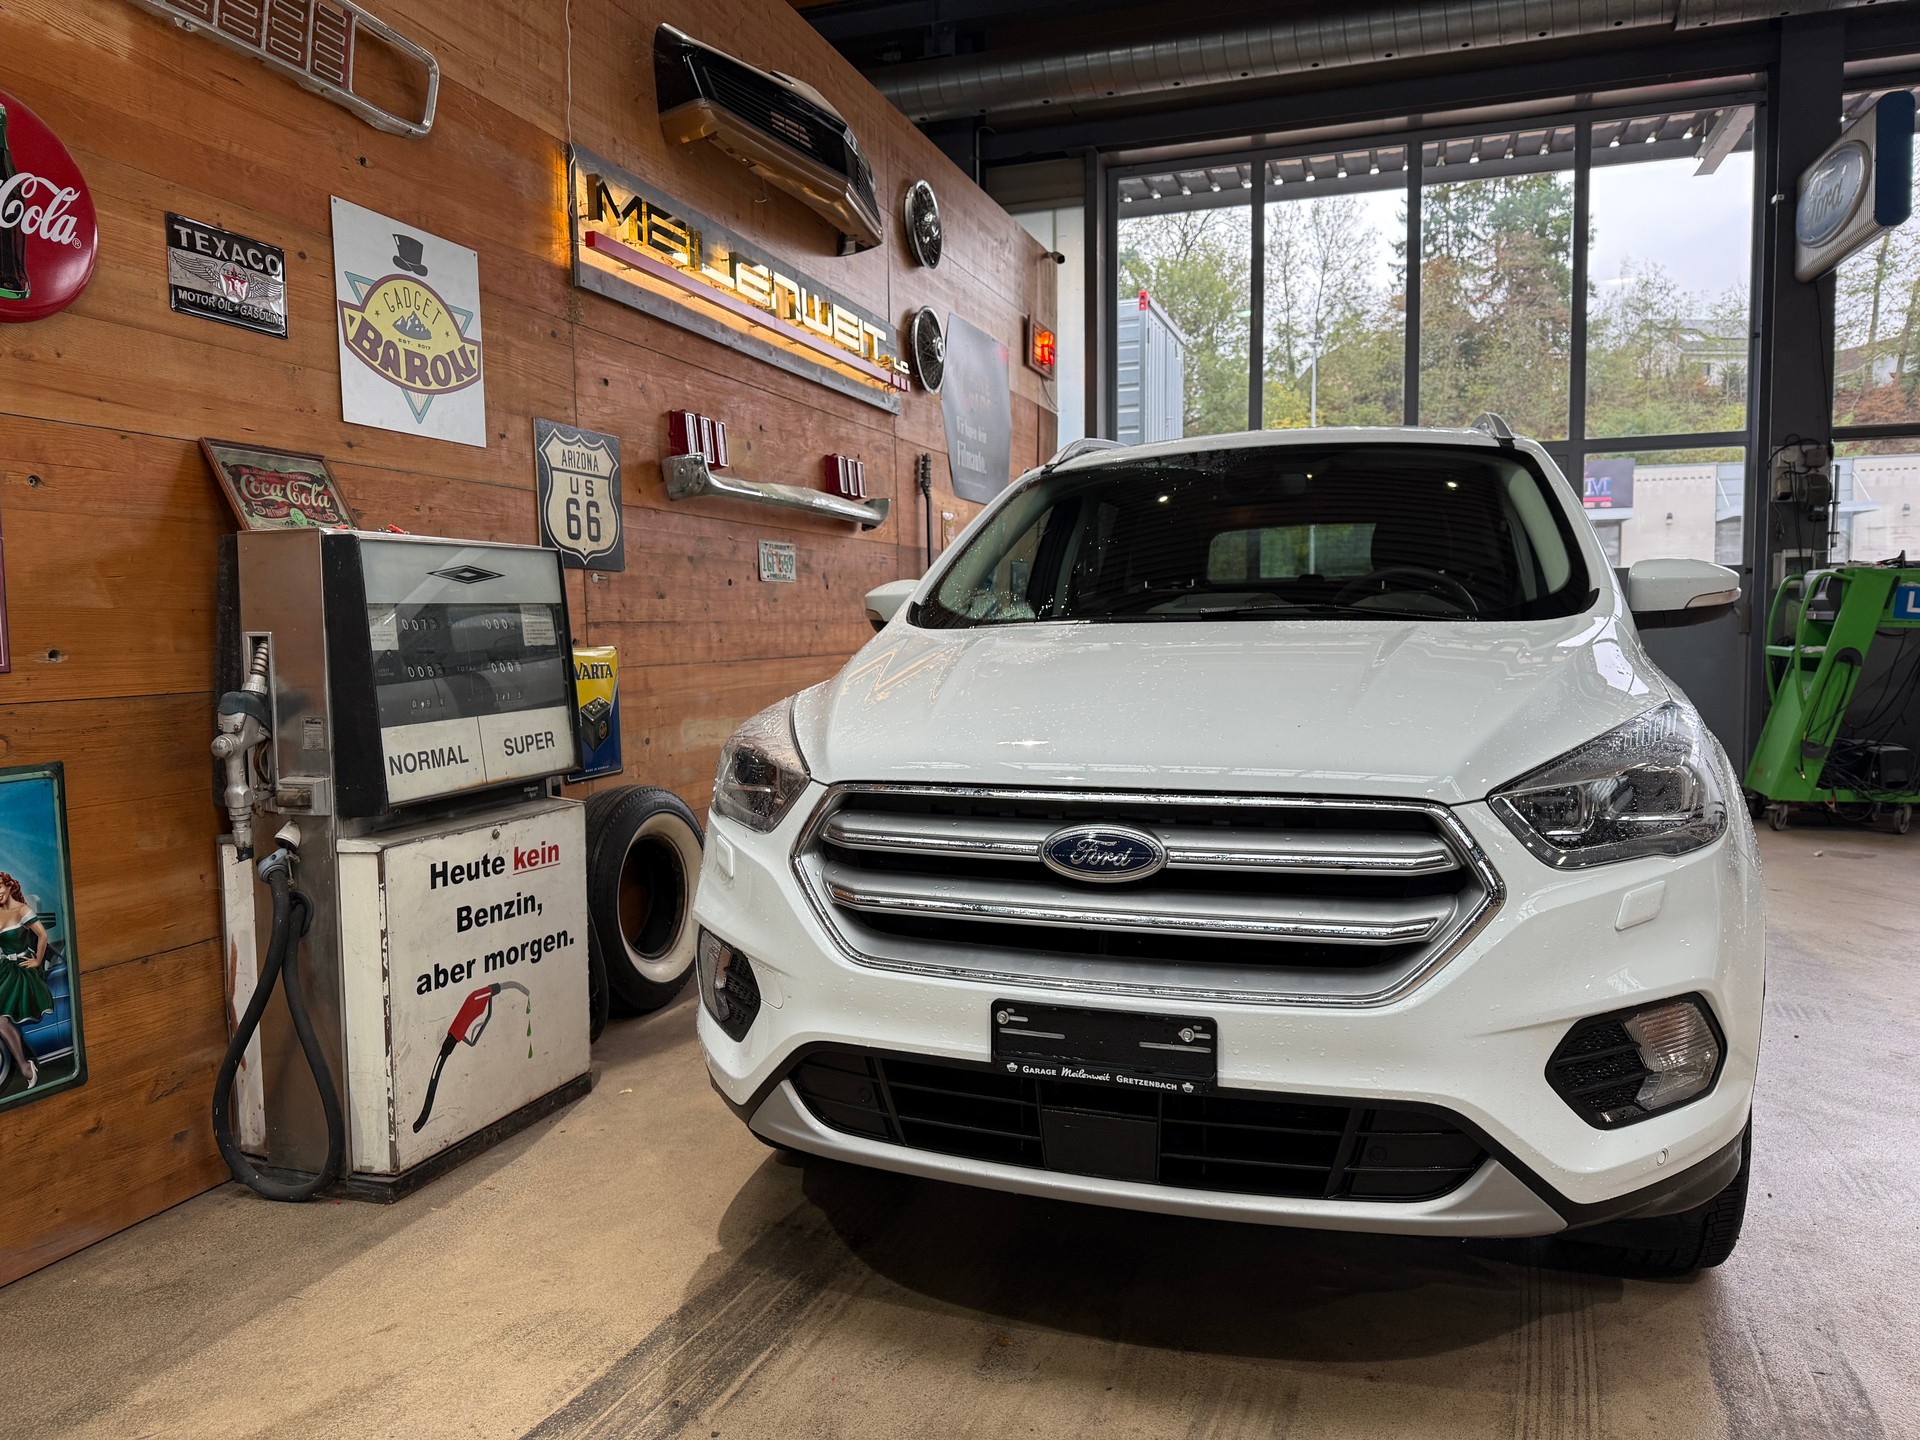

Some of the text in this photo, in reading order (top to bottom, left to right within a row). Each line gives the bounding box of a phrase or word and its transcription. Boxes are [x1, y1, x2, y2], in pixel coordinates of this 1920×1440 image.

[174, 224, 281, 276] TEXACO
[586, 173, 887, 361] MEILENWEIT
[178, 289, 216, 308] MOTOR
[217, 298, 234, 312] OIL
[383, 286, 442, 325] GADGET
[349, 315, 477, 388] BARON
[398, 337, 432, 351] EST. 2017
[561, 448, 600, 472] ARIZONA
[566, 497, 602, 543] 66
[574, 662, 613, 680] VARTA
[389, 745, 469, 776] NORMAL
[503, 730, 556, 757] SUPER
[430, 841, 560, 889] Heute kein
[1070, 838, 1132, 867] Ford
[456, 891, 543, 933] Benzin,
[416, 929, 575, 996] aber morgen.
[1061, 1066, 1110, 1082] Meilenweit
